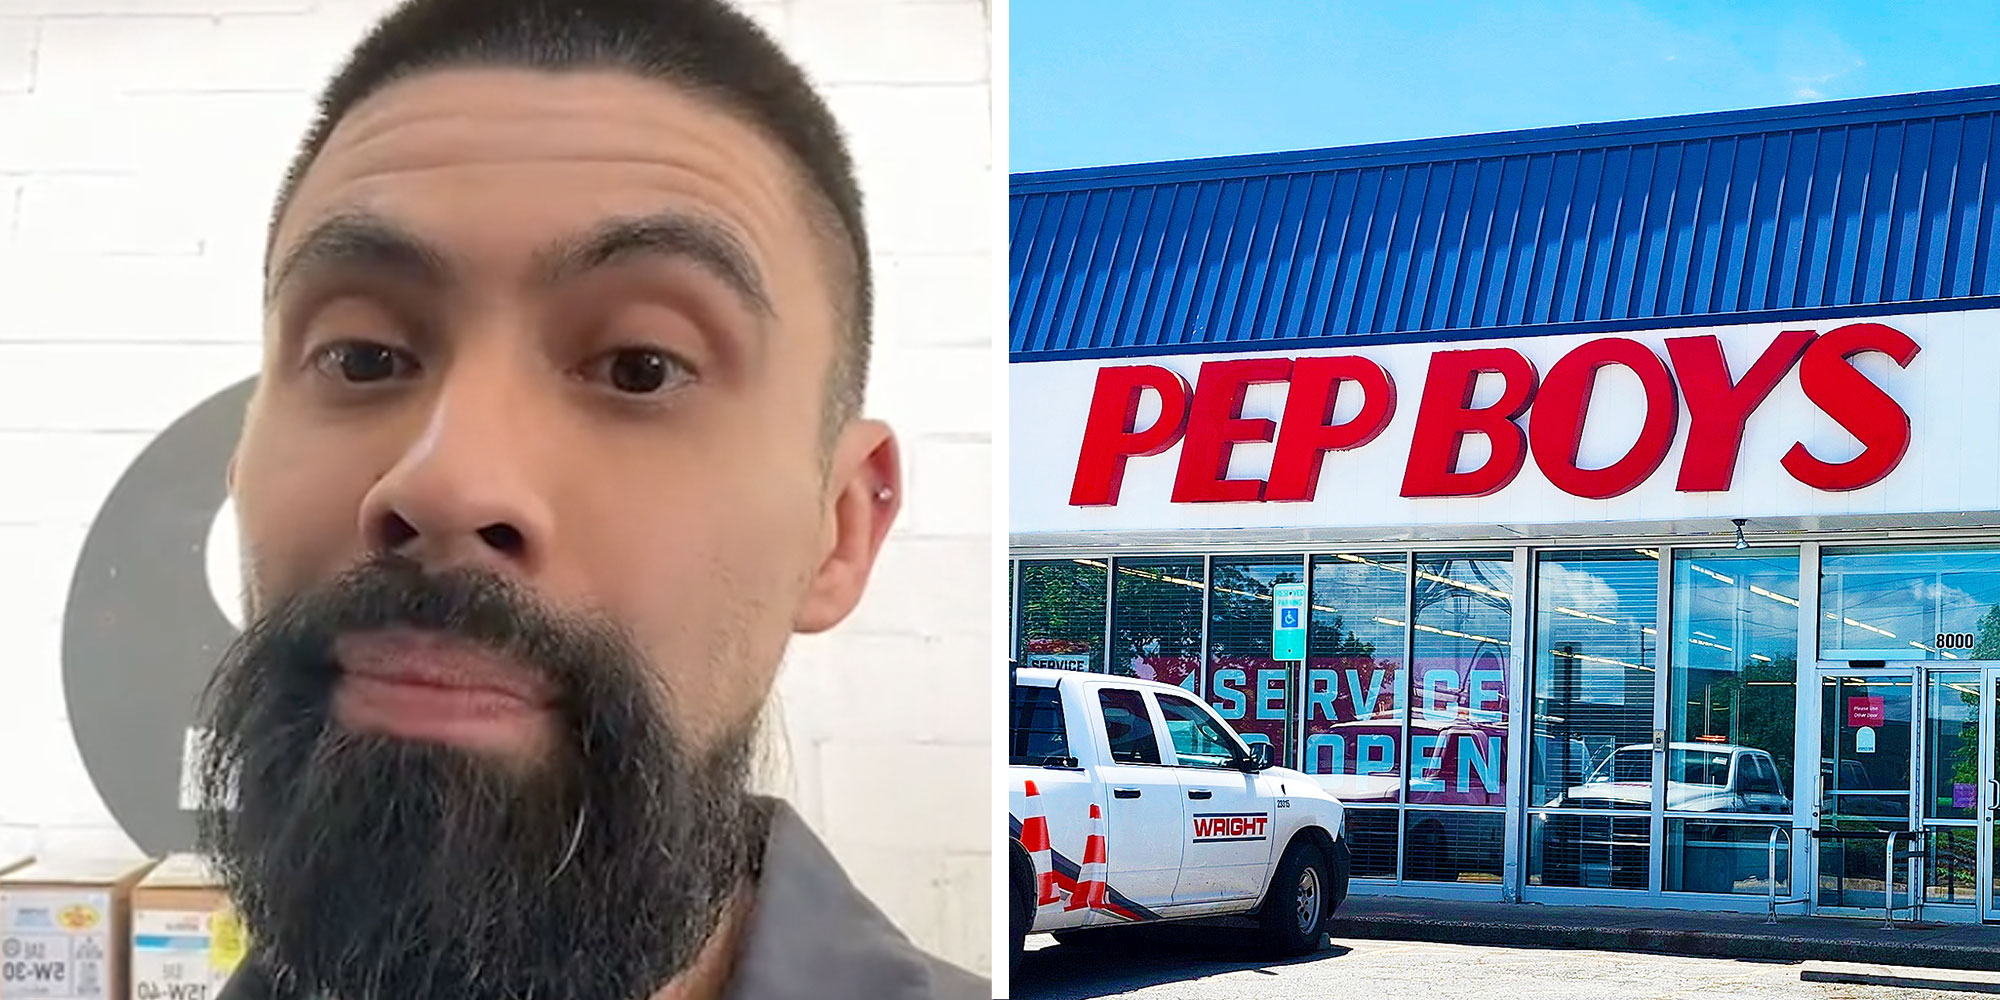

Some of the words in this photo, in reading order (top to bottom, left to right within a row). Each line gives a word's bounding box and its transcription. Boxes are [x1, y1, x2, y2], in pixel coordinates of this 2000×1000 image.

[1069, 355, 1398, 507] PEP
[1400, 323, 1922, 500] BOYS
[1936, 633, 1974, 649] 8000
[1212, 669, 1504, 722] SERVICE
[1306, 733, 1502, 795] OPEN
[1193, 817, 1268, 837] WRIGHT
